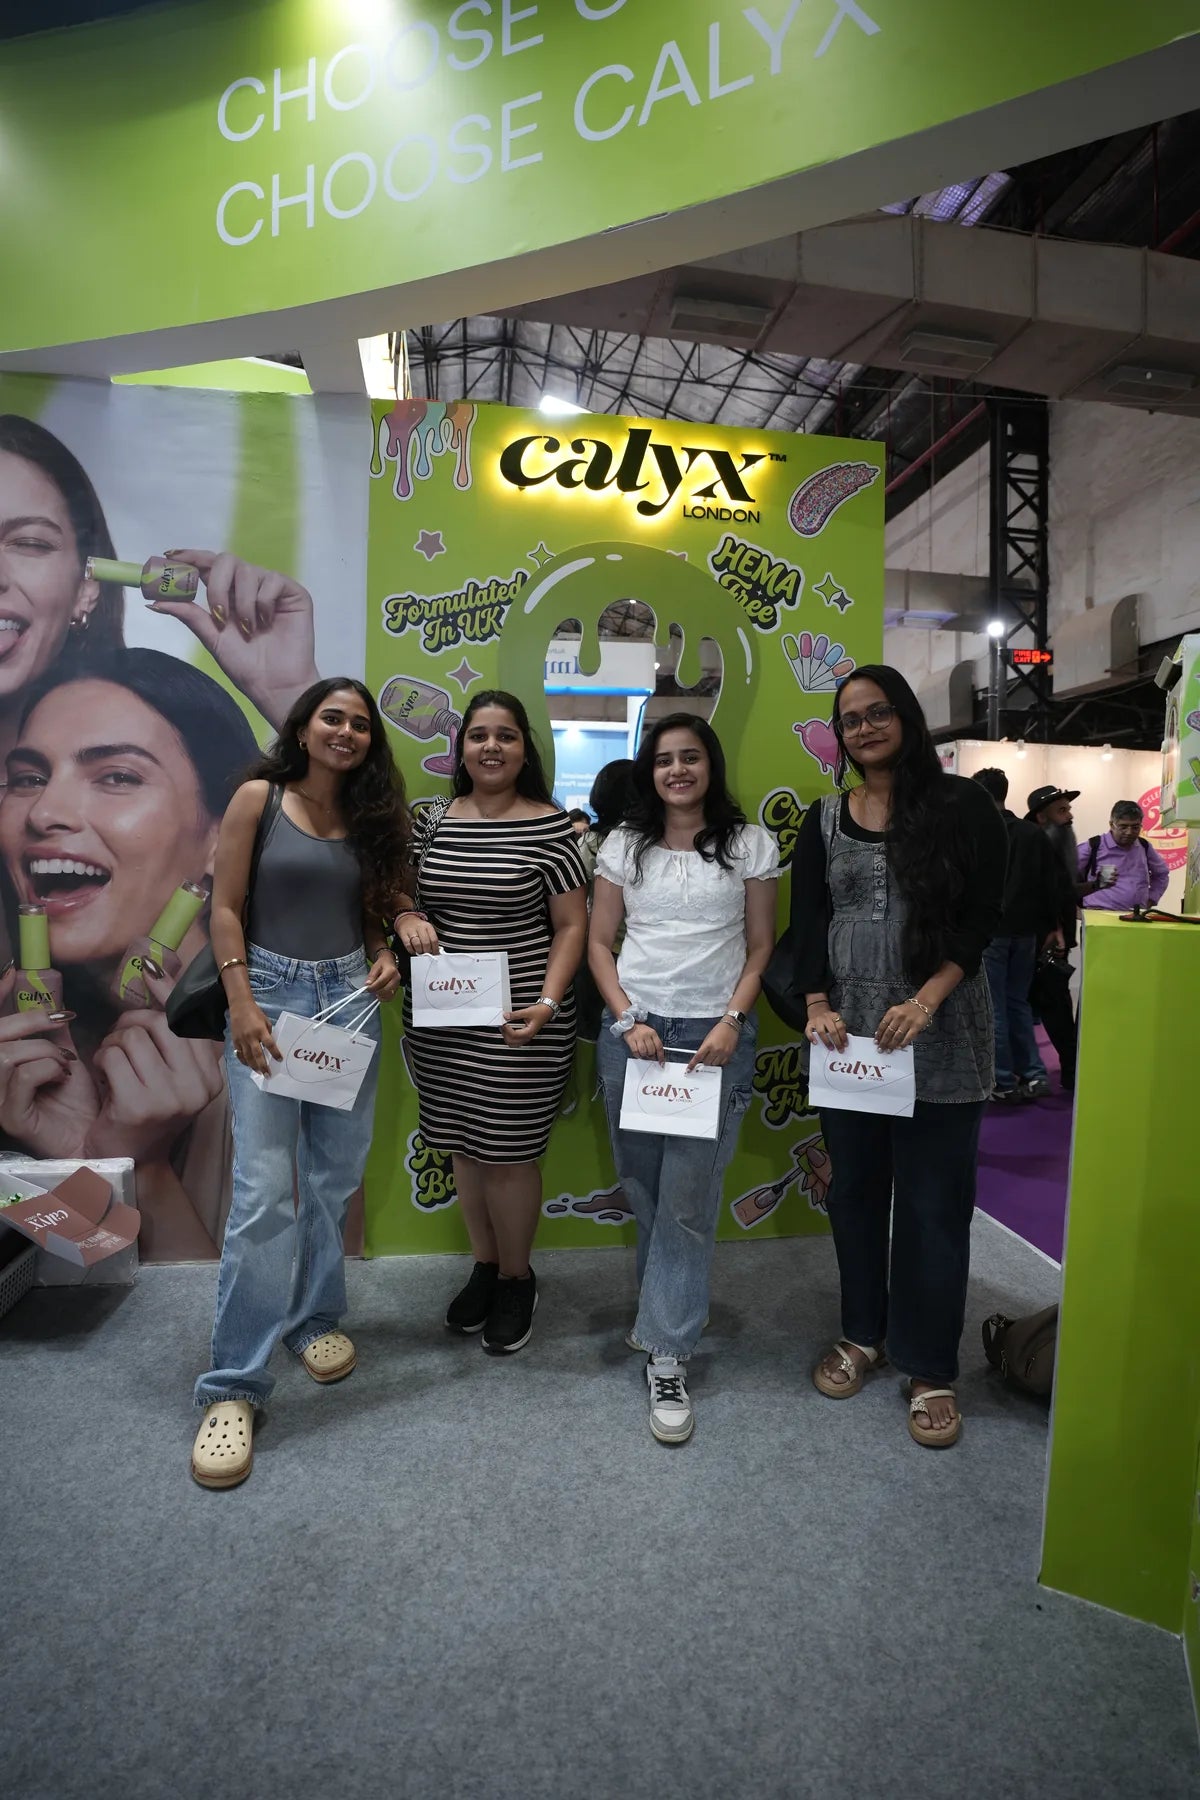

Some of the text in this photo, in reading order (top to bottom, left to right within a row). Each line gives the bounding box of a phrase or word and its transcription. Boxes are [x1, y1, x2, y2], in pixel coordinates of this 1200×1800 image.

[217, 0, 544, 141] CHOOSE
[216, 91, 544, 246] CHOOSE
[682, 504, 760, 524] LONDON
[713, 537, 799, 600] HEMA
[386, 572, 524, 631] Formulated
[423, 605, 502, 650] In UK
